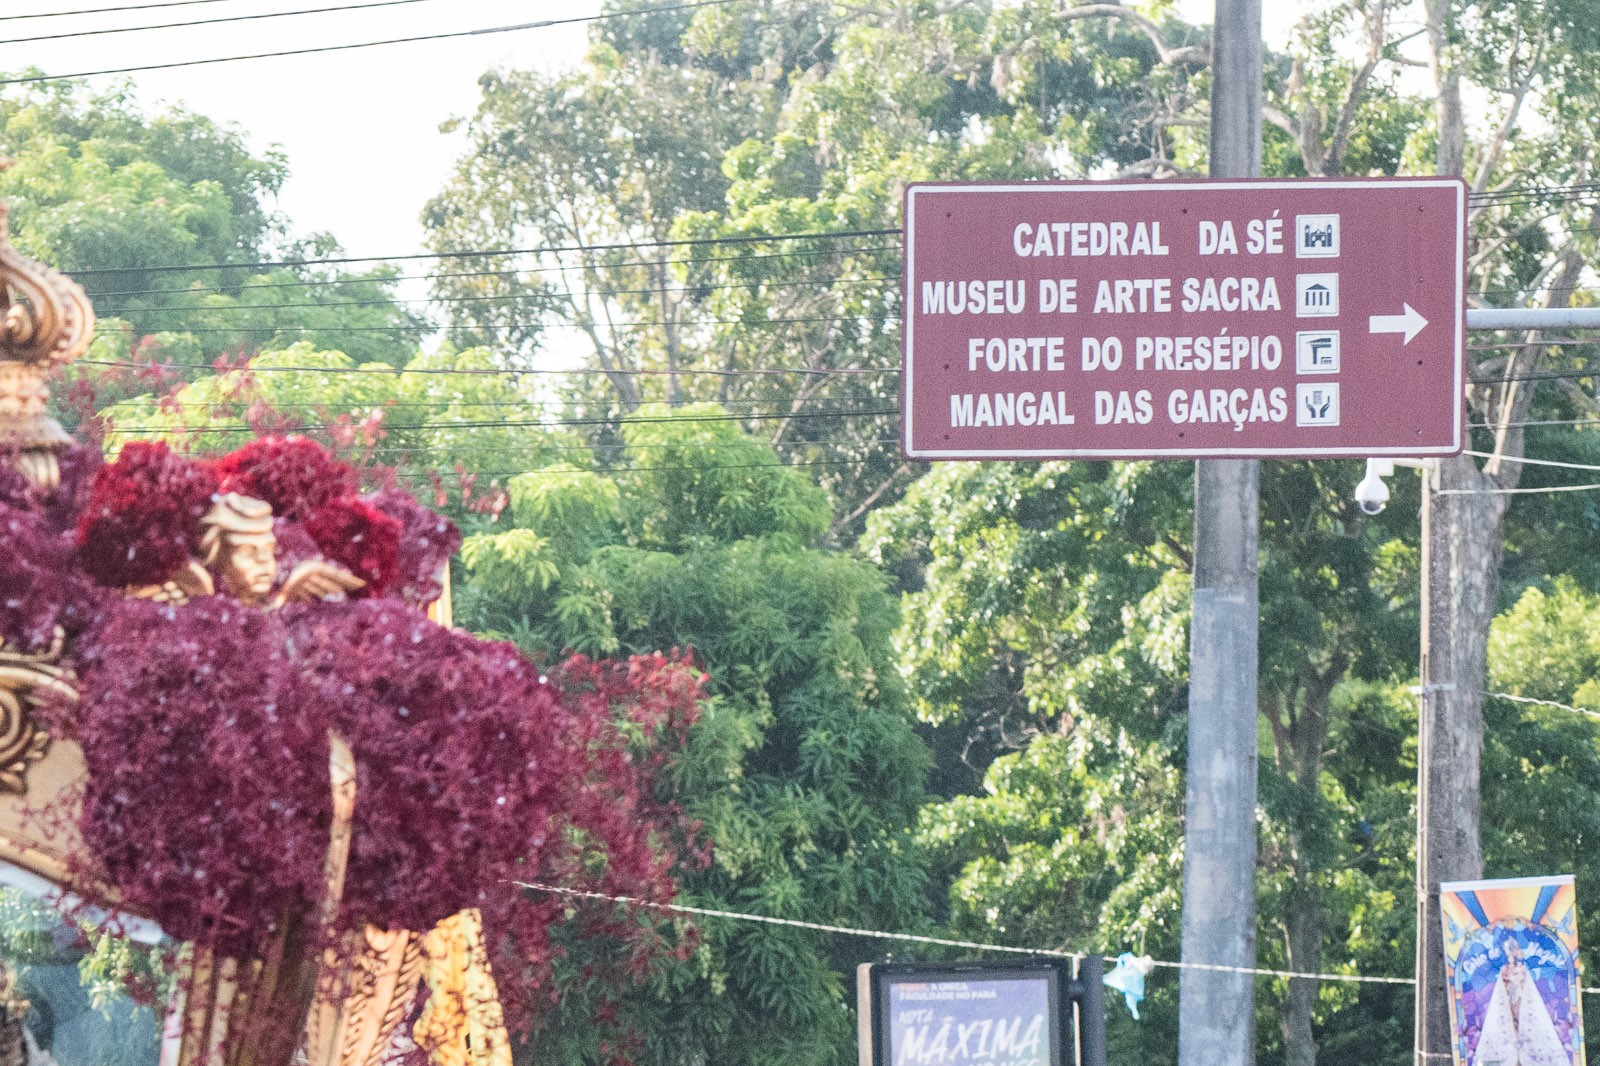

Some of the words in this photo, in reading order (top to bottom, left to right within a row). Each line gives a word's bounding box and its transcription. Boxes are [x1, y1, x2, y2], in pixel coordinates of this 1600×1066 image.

[1013, 220, 1169, 257] CATEDRAL
[1199, 220, 1238, 255] DA
[1246, 210, 1283, 254] SÉ
[922, 280, 1025, 315] MUSEU
[1040, 279, 1077, 314] DE
[1093, 279, 1172, 313] ARTE
[1182, 277, 1281, 312] SACRA
[968, 337, 1064, 372] FORTE
[1082, 337, 1122, 371] DO
[1136, 327, 1282, 371] PRESÉPIO
[951, 391, 1074, 428] MANGAL
[1095, 389, 1153, 425] DAS
[1168, 387, 1287, 431] GARÇAS
[897, 1014, 1045, 1066] MÁXIMA
